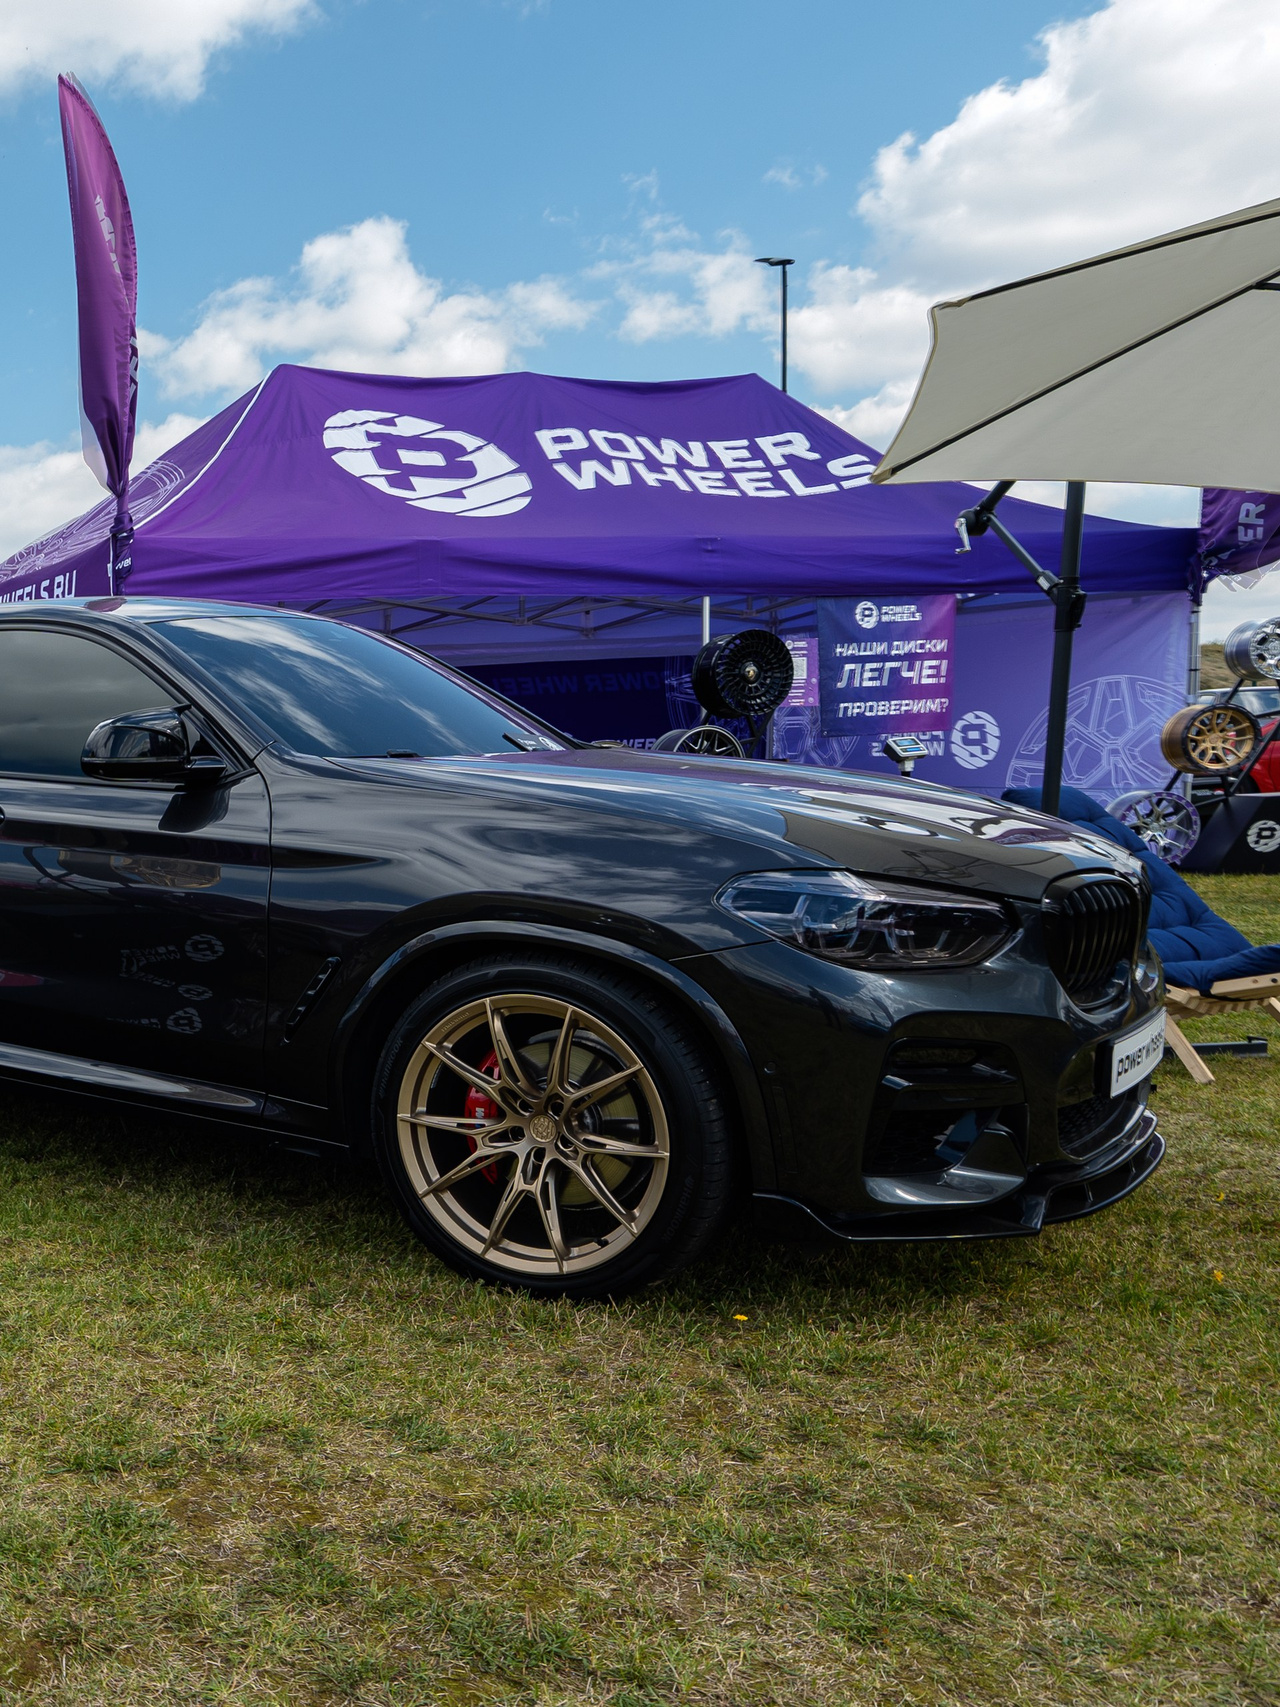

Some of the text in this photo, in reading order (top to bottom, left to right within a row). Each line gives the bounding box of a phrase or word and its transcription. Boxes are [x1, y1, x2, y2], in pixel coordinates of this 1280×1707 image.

[534, 427, 822, 468] POWER
[552, 453, 877, 498] WHEELS
[880, 605, 918, 614] POWER
[880, 612, 923, 622] WHEELS
[835, 639, 948, 657] НАШИ ДИСКИ
[836, 660, 948, 688] ЛЕГЧЕ!
[837, 698, 949, 717] ПРОВЕРИМ?
